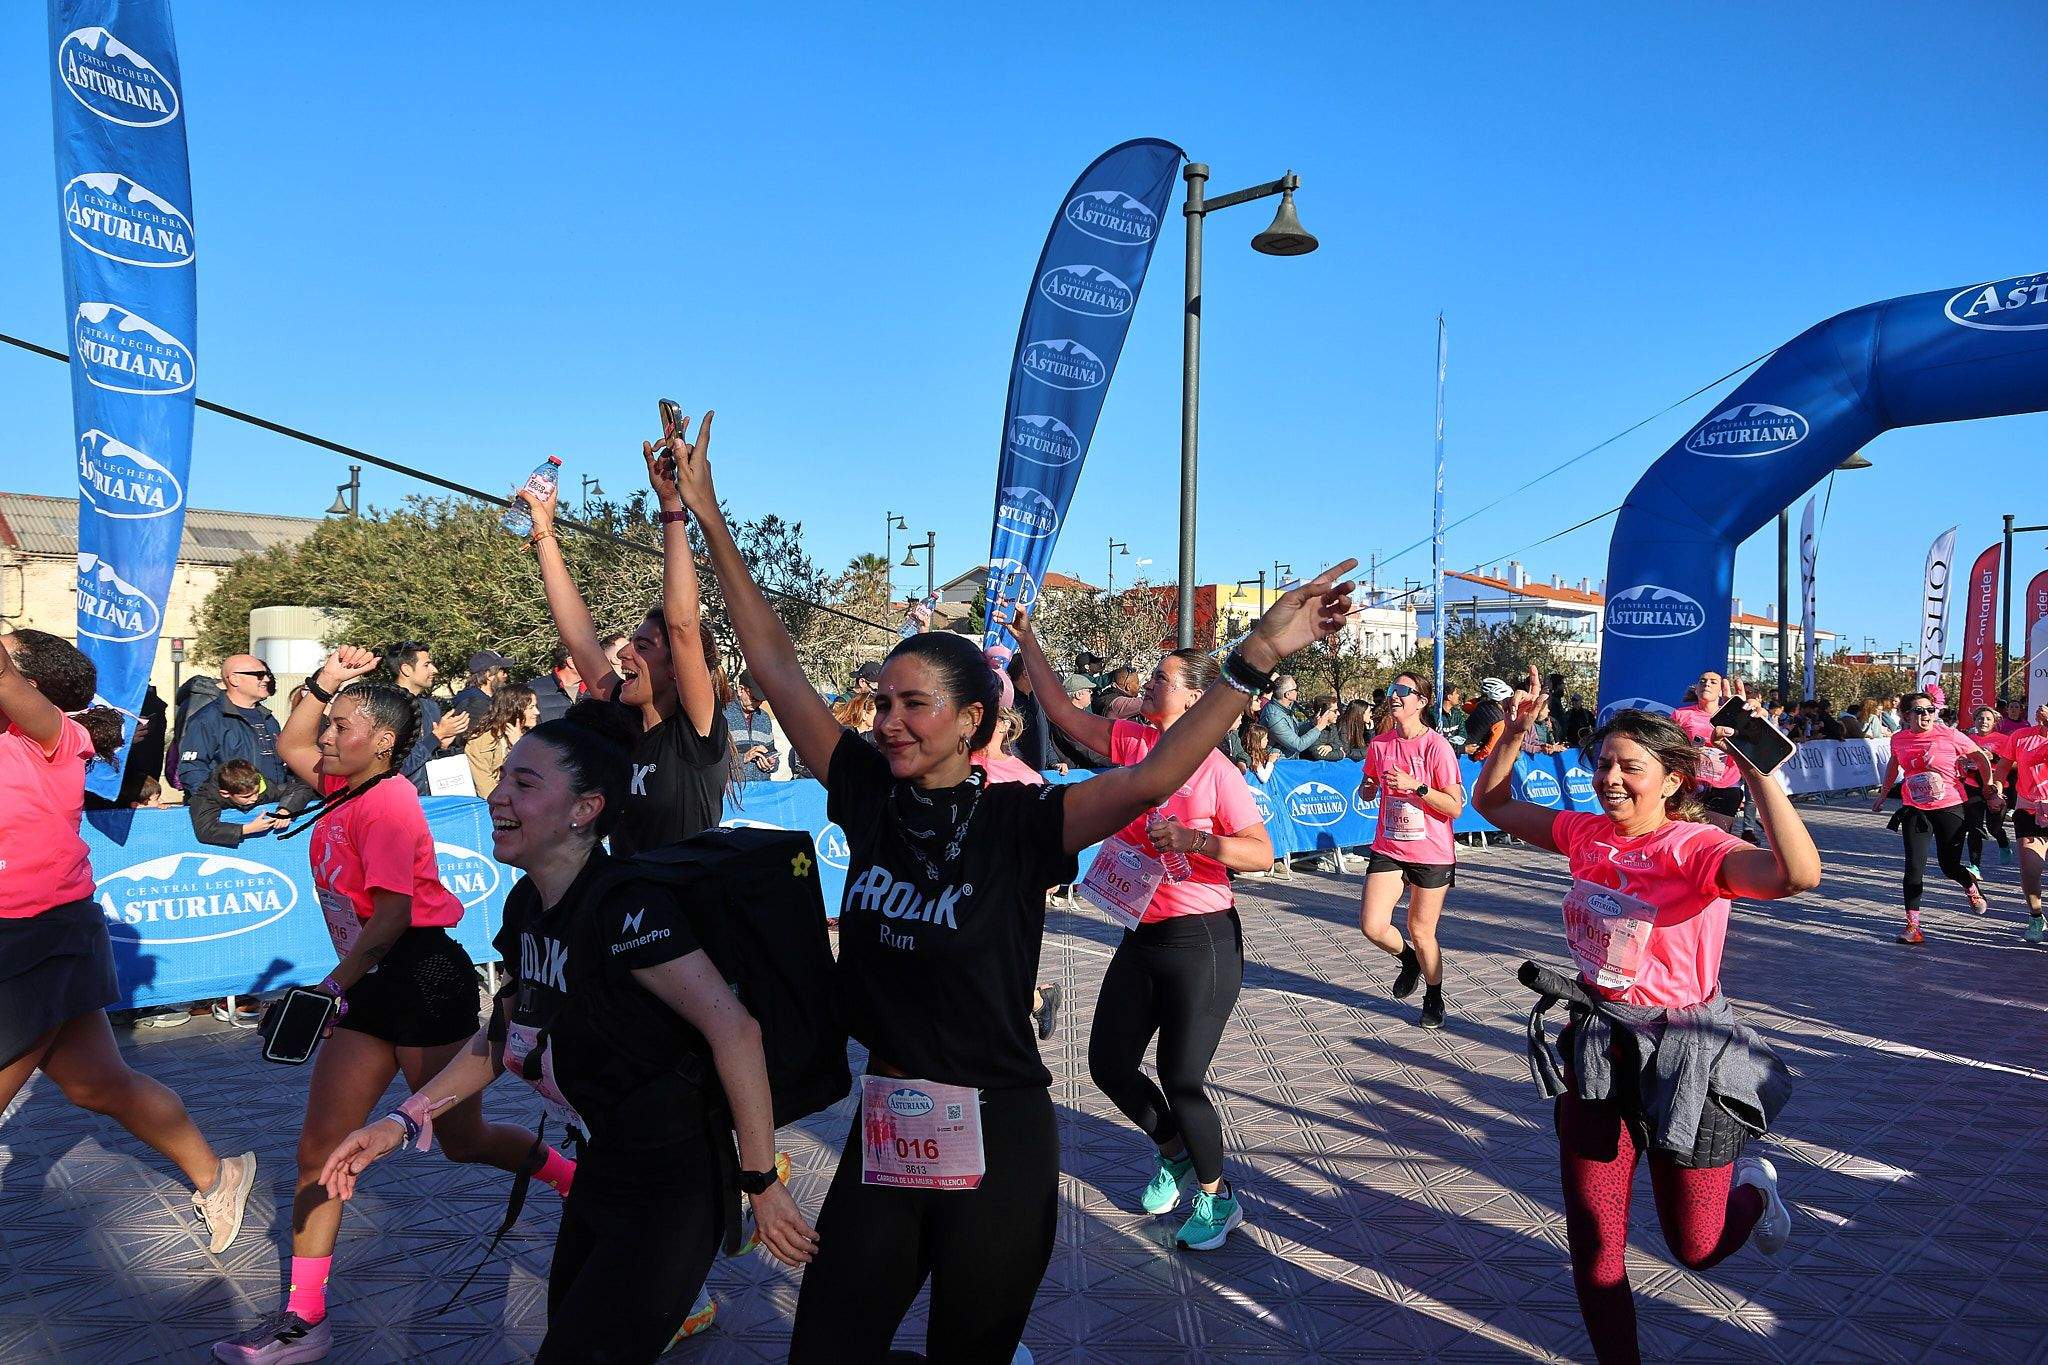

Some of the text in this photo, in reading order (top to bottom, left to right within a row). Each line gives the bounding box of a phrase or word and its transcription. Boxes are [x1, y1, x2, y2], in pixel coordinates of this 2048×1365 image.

[67, 49, 169, 113] ASTURIANA
[111, 64, 157, 84] LECHERA
[84, 194, 182, 229] CENTRAL LECHERA
[1070, 200, 1151, 238] ASTURIANA
[67, 191, 188, 256] ASTURIANA
[1046, 274, 1124, 311] ASTURIANA
[120, 336, 181, 359] LECHERA
[1024, 349, 1096, 384] ASTURIANA
[1691, 425, 1798, 448] ASTURIANA
[103, 462, 164, 483] LECHERA
[998, 504, 1052, 531] STURIANA
[1607, 605, 1697, 627] ASTURIANA
[1976, 568, 1993, 646] Santander
[1836, 745, 1872, 767] OYSHO
[1292, 798, 1344, 817] ASTURIANA
[1393, 816, 1410, 824] 016
[438, 860, 480, 872] CHERA
[126, 877, 274, 897] CENTRAL LECHERA
[1107, 872, 1131, 893] 016
[101, 889, 283, 924] ASTURIANA
[611, 928, 671, 956] RunnerPro
[880, 923, 916, 951] Run
[1586, 925, 1611, 949] 016
[890, 1098, 931, 1110] ASTURIANA
[896, 1137, 940, 1160] 016
[905, 1165, 927, 1175] 8613
[938, 1179, 967, 1187] VALENCIA
